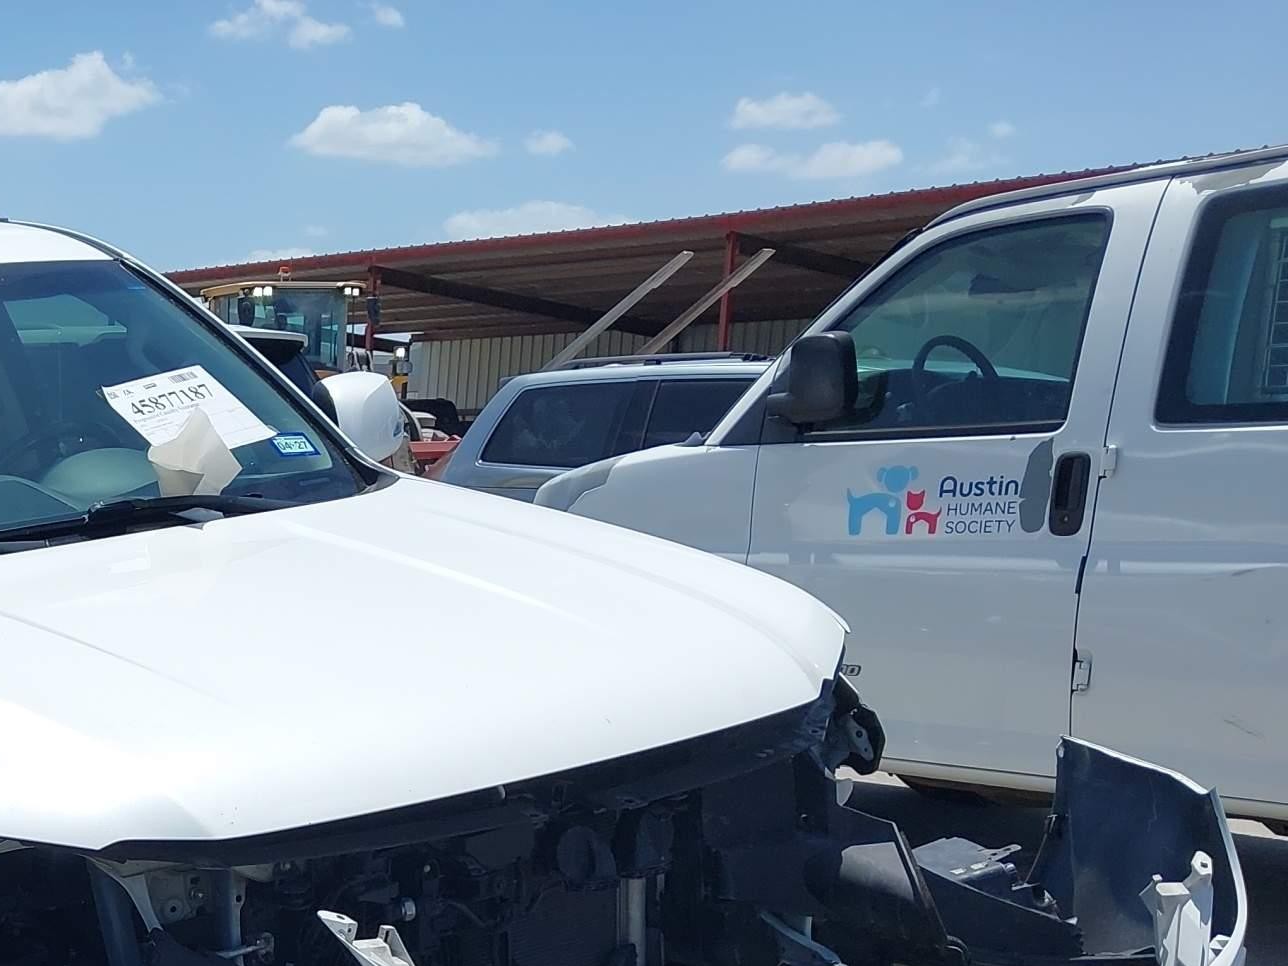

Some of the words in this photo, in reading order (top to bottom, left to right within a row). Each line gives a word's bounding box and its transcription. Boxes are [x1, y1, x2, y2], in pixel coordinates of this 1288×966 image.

[131, 384, 213, 415] 45877187
[939, 475, 1019, 498] Austin
[946, 501, 1018, 516] HUMANE
[944, 520, 1016, 534] SOCIETY
